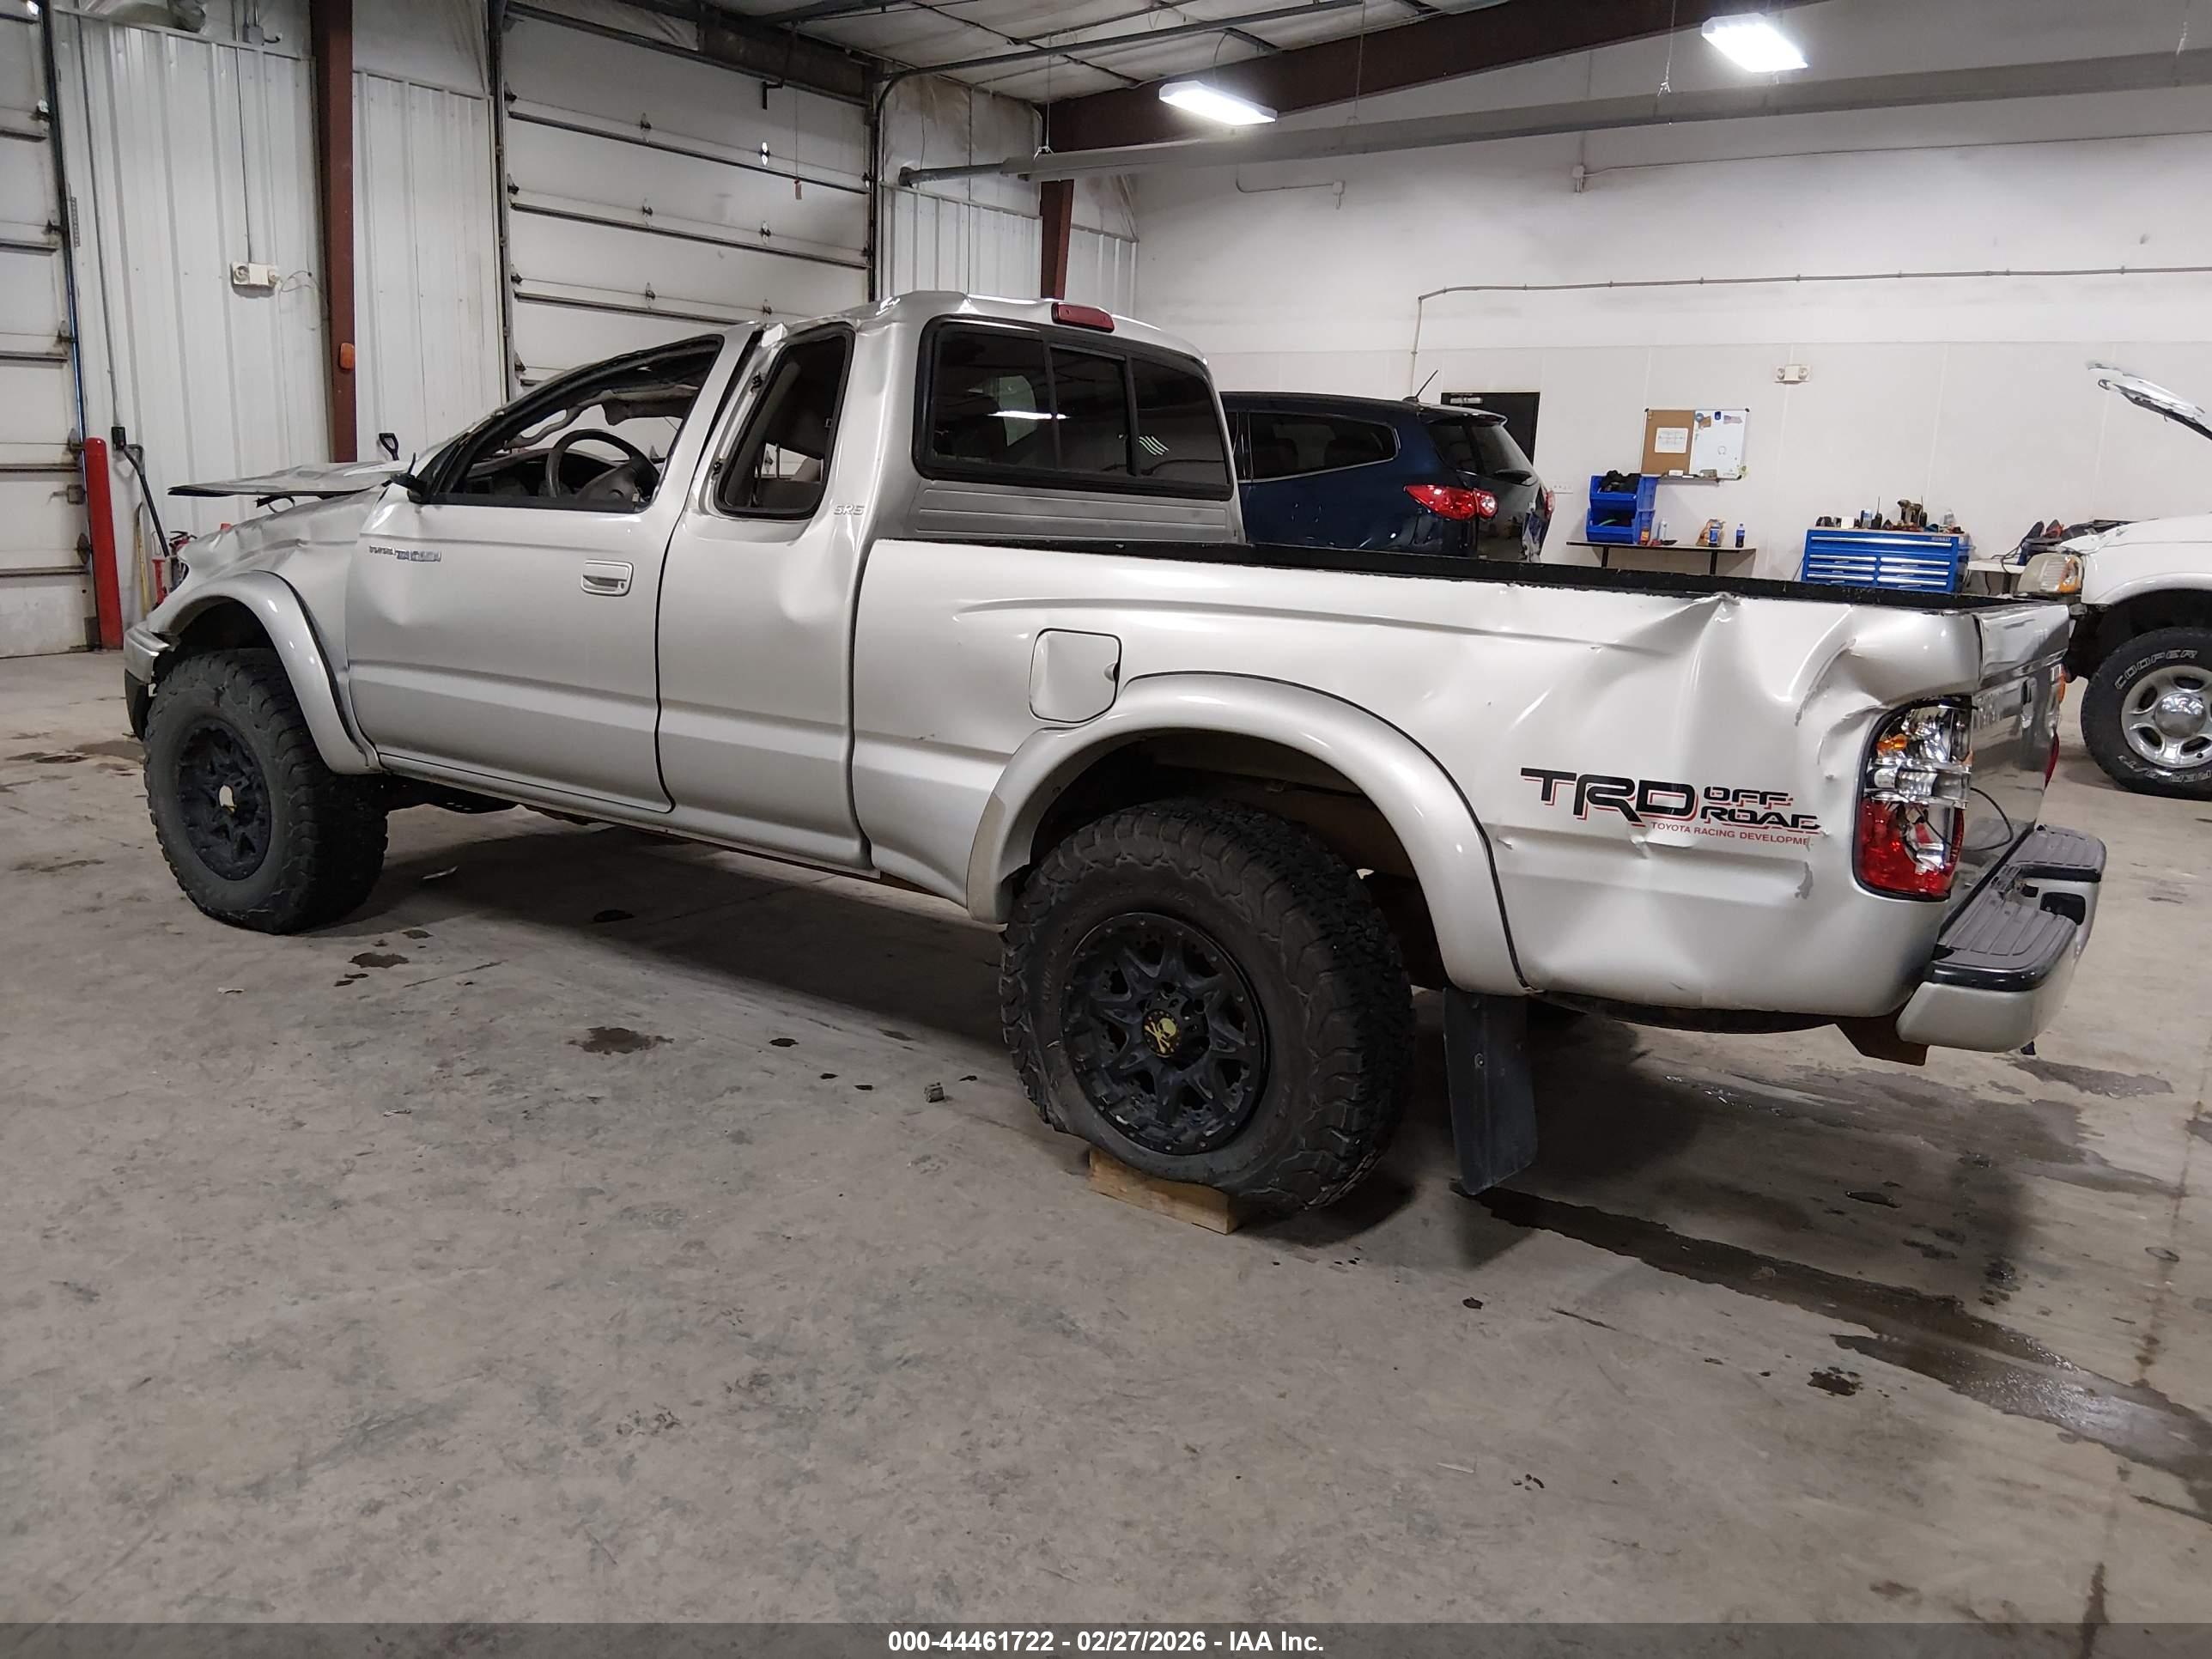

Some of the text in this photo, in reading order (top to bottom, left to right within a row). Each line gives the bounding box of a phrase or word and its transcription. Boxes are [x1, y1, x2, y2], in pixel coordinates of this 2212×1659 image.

[834, 505, 865, 515] SR5
[2115, 650, 2197, 690] COOPER
[1521, 767, 1698, 826] TRD
[1704, 787, 1792, 809] OFF
[1650, 822, 1691, 833] TOYOTA
[1694, 827, 1735, 838] RACING
